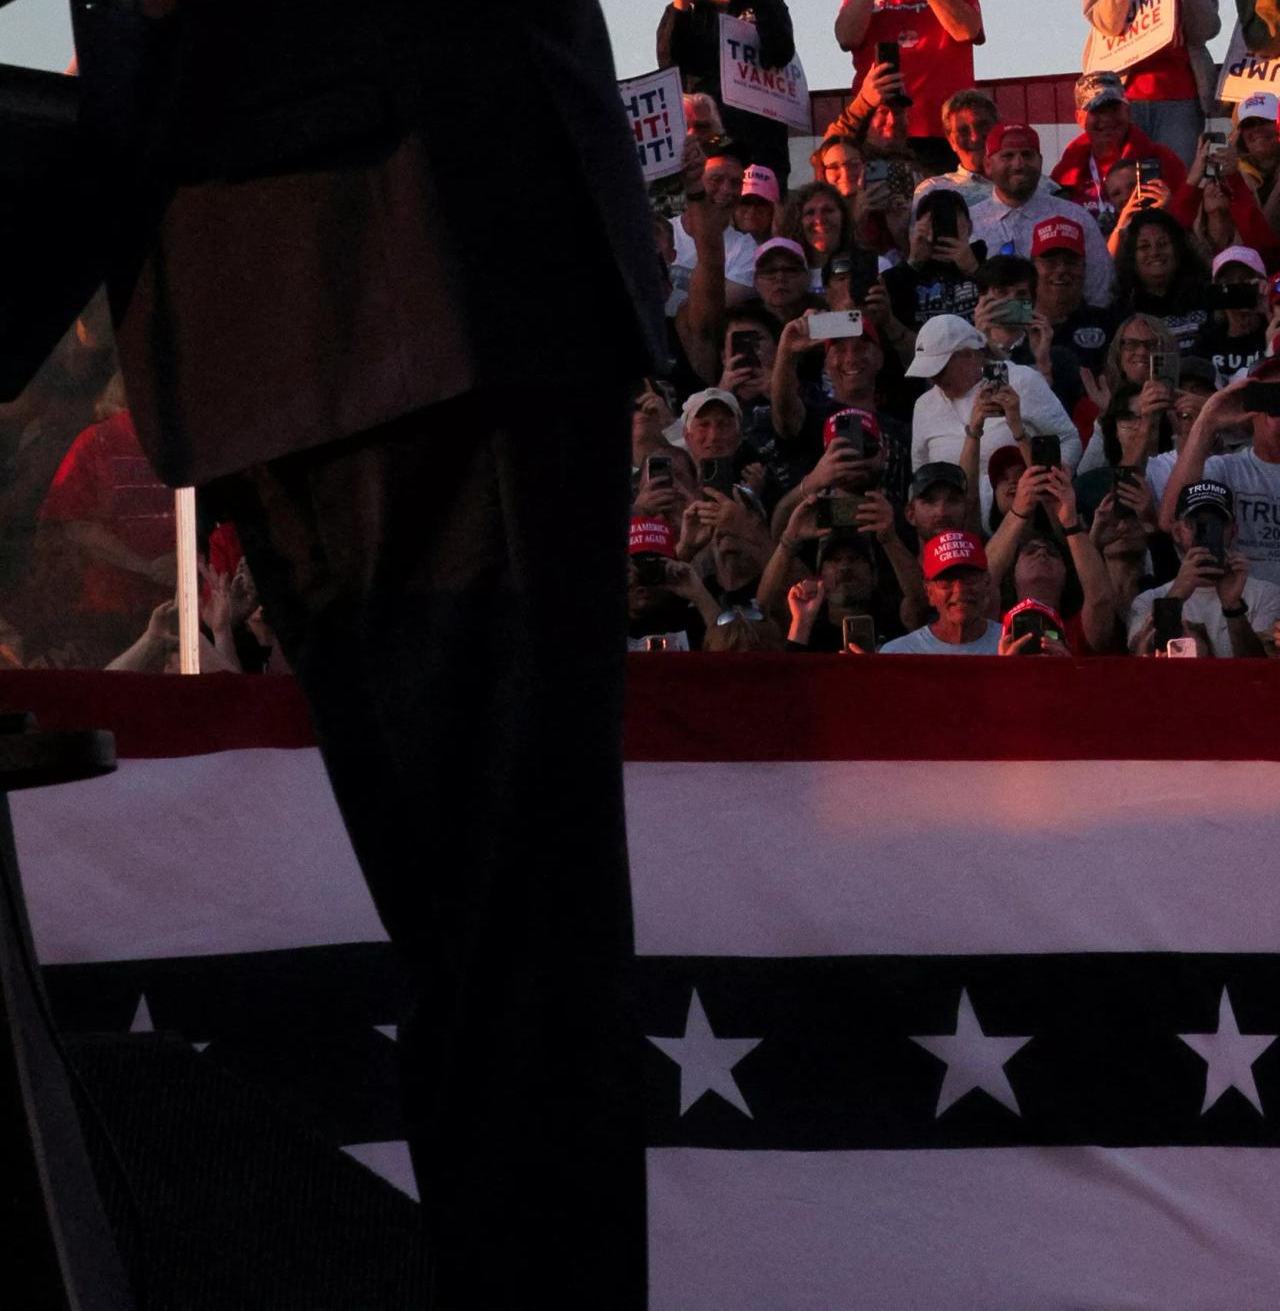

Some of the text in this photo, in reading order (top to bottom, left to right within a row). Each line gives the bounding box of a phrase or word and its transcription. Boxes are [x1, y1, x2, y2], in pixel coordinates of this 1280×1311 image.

[1106, 7, 1162, 50] VANCE
[736, 62, 797, 98] VANCE
[1212, 353, 1259, 371] RUM
[1188, 483, 1227, 496] TRUMP
[636, 523, 670, 535] AMERICA
[644, 533, 667, 545] AGAIN
[939, 532, 964, 544] KEEP
[934, 541, 976, 556] AMERICA
[939, 549, 971, 563] GREAT
